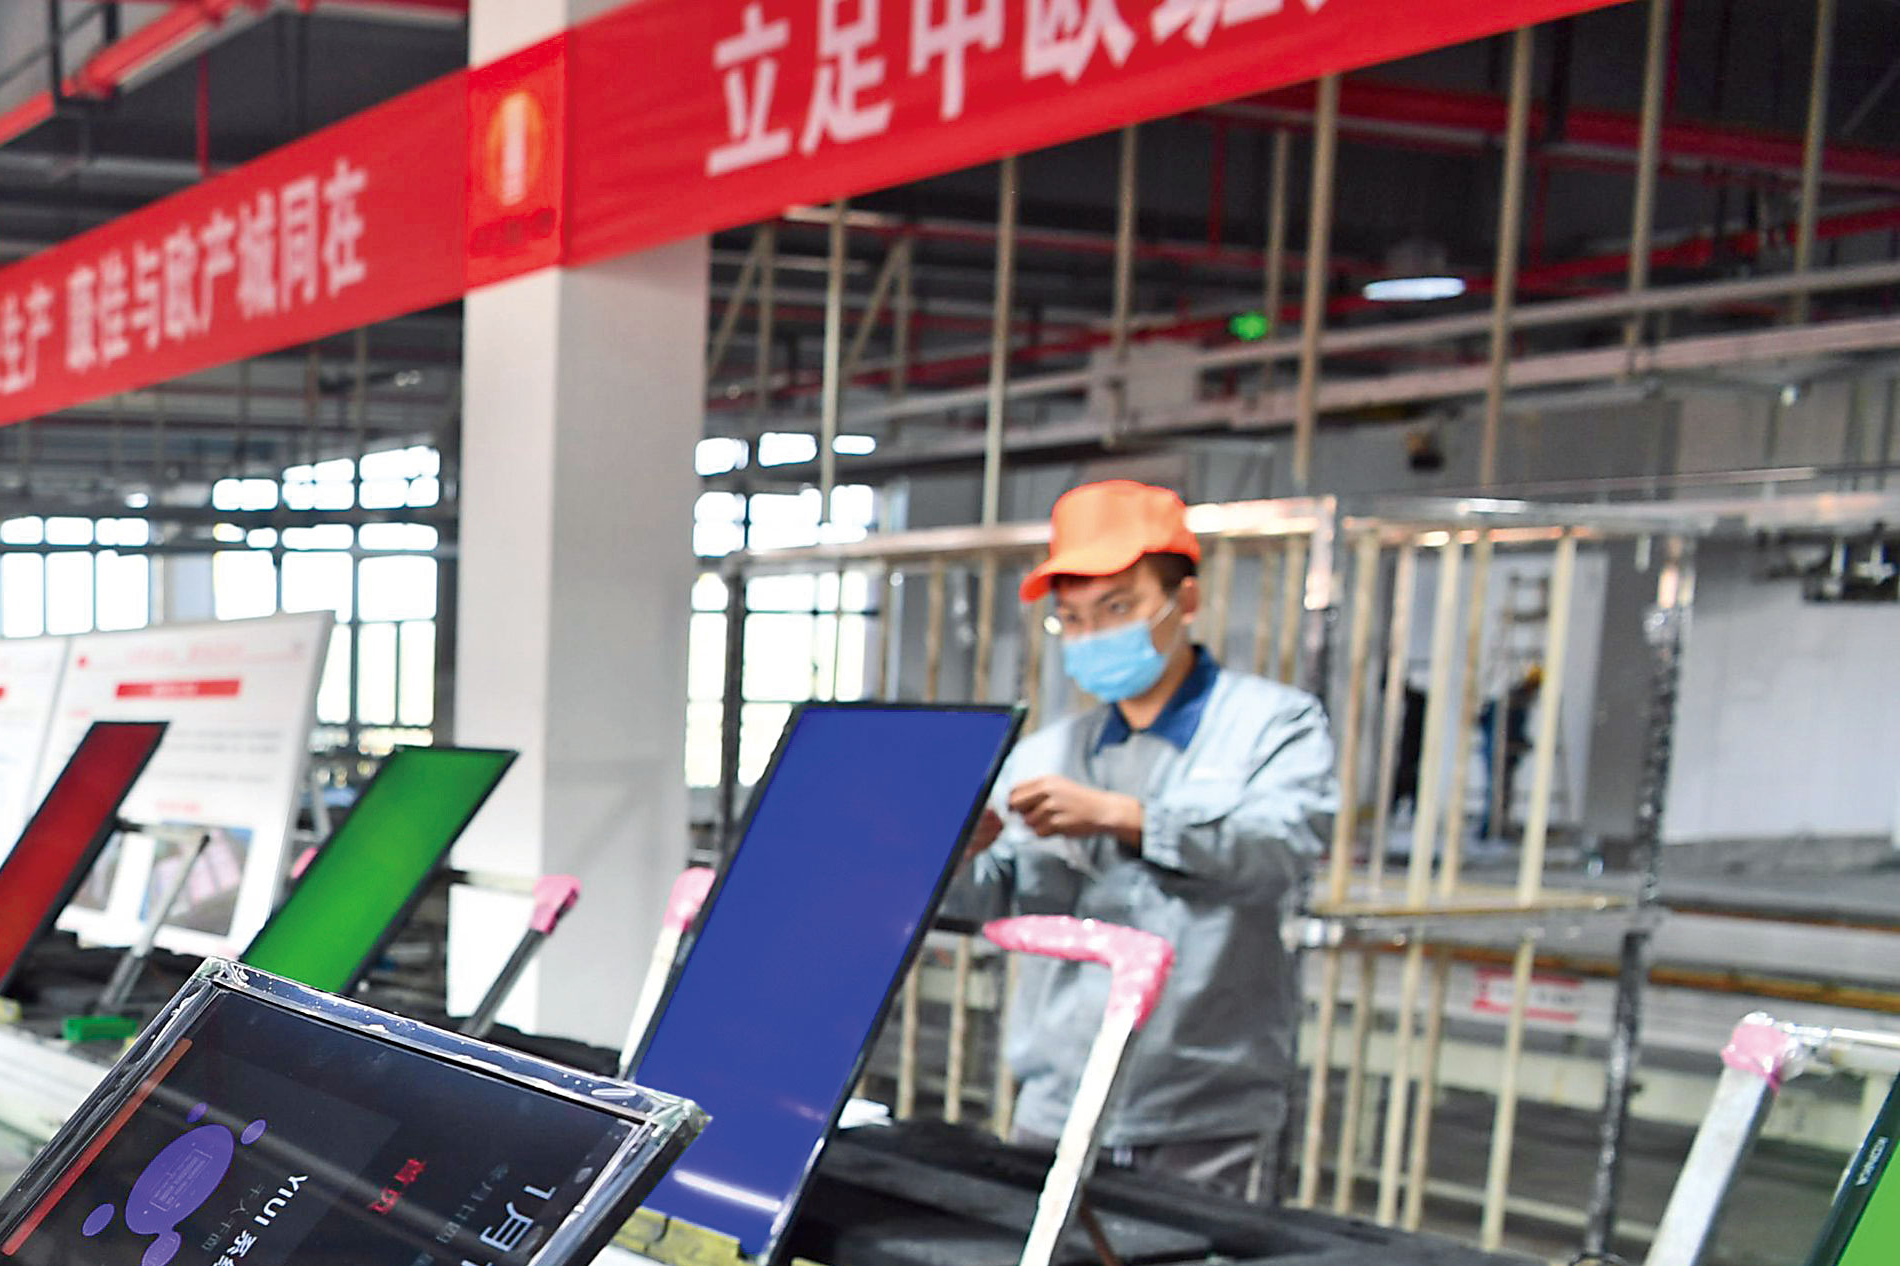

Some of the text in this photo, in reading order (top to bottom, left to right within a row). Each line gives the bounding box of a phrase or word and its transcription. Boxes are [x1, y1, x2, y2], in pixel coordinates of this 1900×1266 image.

[704, 0, 1328, 177] 立足中
[255, 1176, 307, 1225] YIUI
[371, 1159, 423, 1212] 首页
